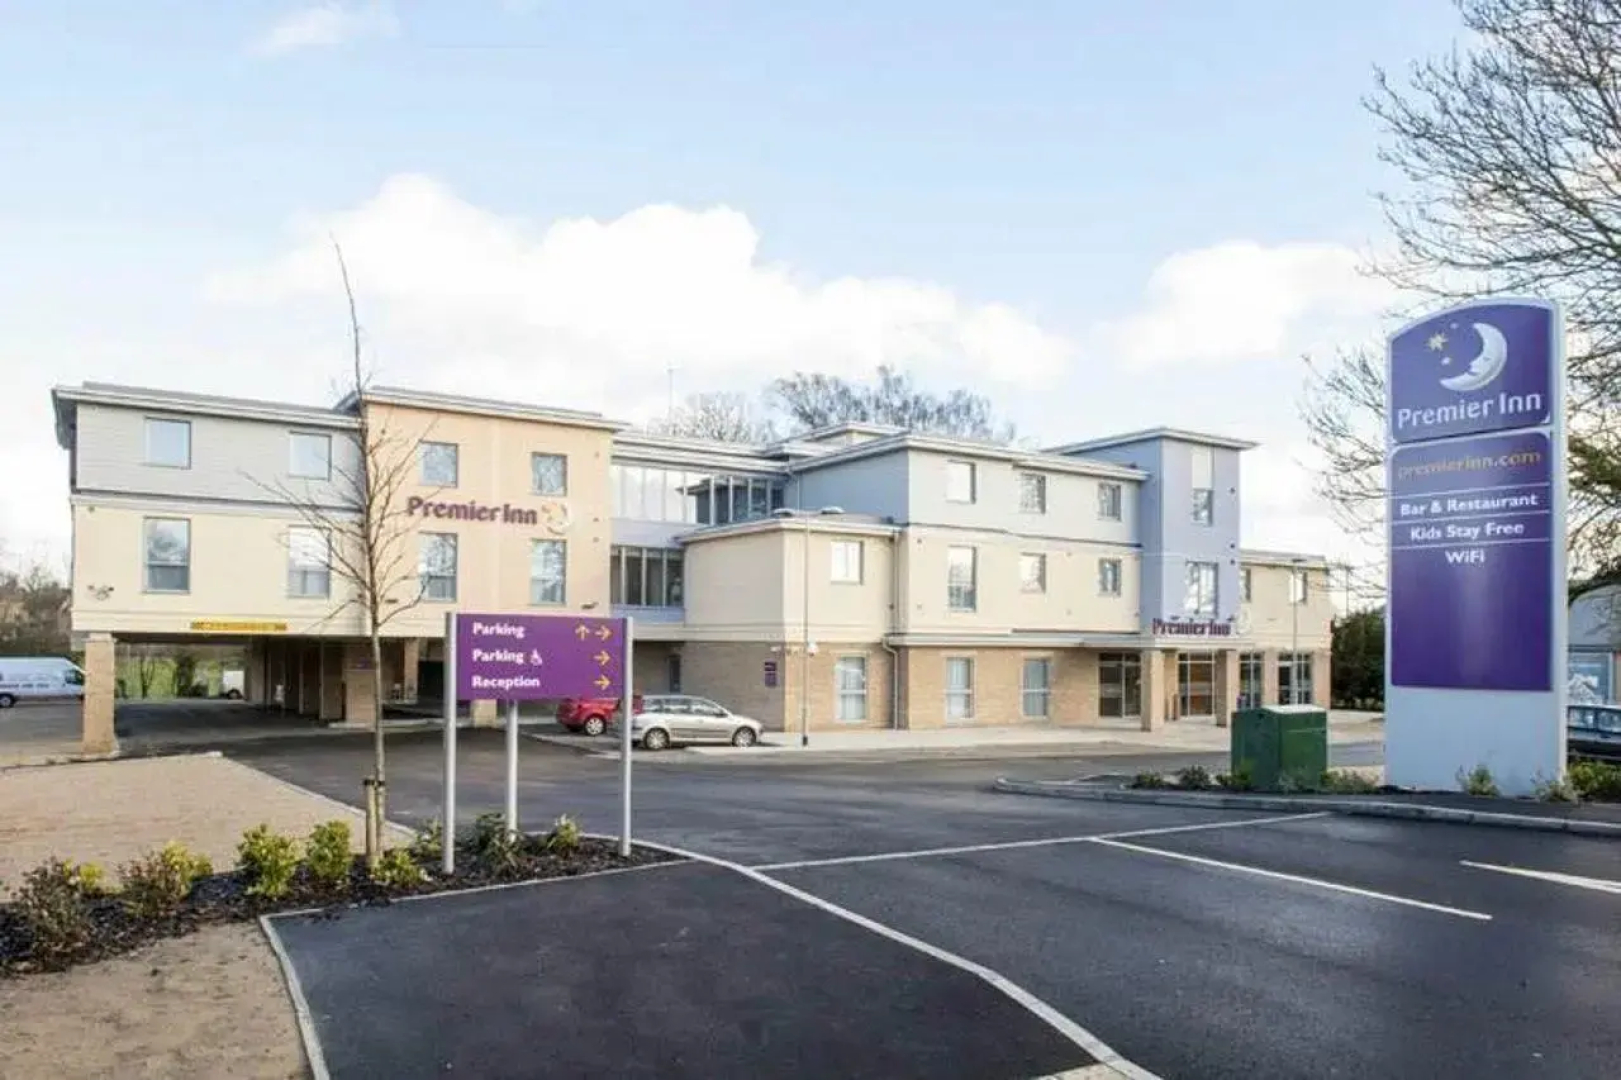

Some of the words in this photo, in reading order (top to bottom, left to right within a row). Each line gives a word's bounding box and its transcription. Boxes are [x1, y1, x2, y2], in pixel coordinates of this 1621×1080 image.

[1397, 399, 1494, 429] Premier
[1499, 391, 1541, 415] Inn
[1399, 450, 1541, 480] premierinn.com
[407, 495, 500, 523] Premier
[503, 503, 538, 525] Inn
[1401, 502, 1426, 517] Bar
[1430, 500, 1443, 514] &
[1447, 493, 1539, 512] Restaurant
[1410, 526, 1442, 541] Kids
[1446, 523, 1480, 540] Stay
[1485, 521, 1525, 537] Free
[1444, 549, 1486, 563] WiFi
[472, 621, 526, 639] Parking
[1152, 617, 1206, 636] Premier
[472, 648, 524, 665] Parking
[471, 675, 541, 691] Reception
